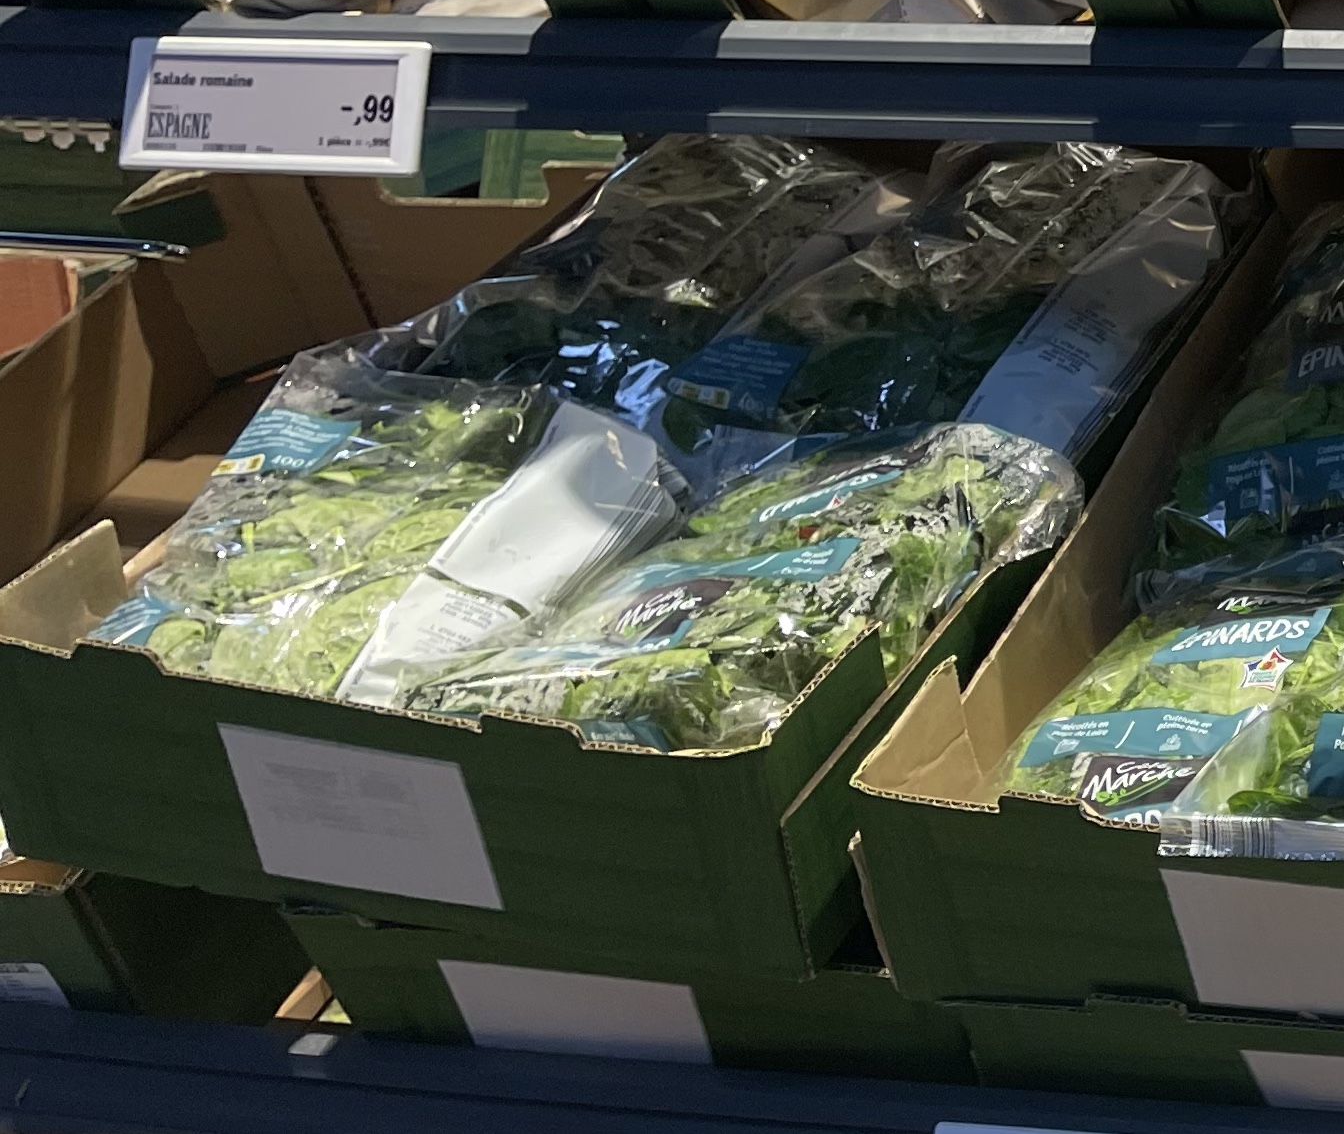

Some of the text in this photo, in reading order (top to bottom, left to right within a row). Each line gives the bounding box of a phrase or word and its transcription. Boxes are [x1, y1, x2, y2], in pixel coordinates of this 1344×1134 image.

[153, 72, 254, 88] Salade romaine
[340, 94, 394, 126] -,99
[147, 111, 213, 140] ESPAGNE
